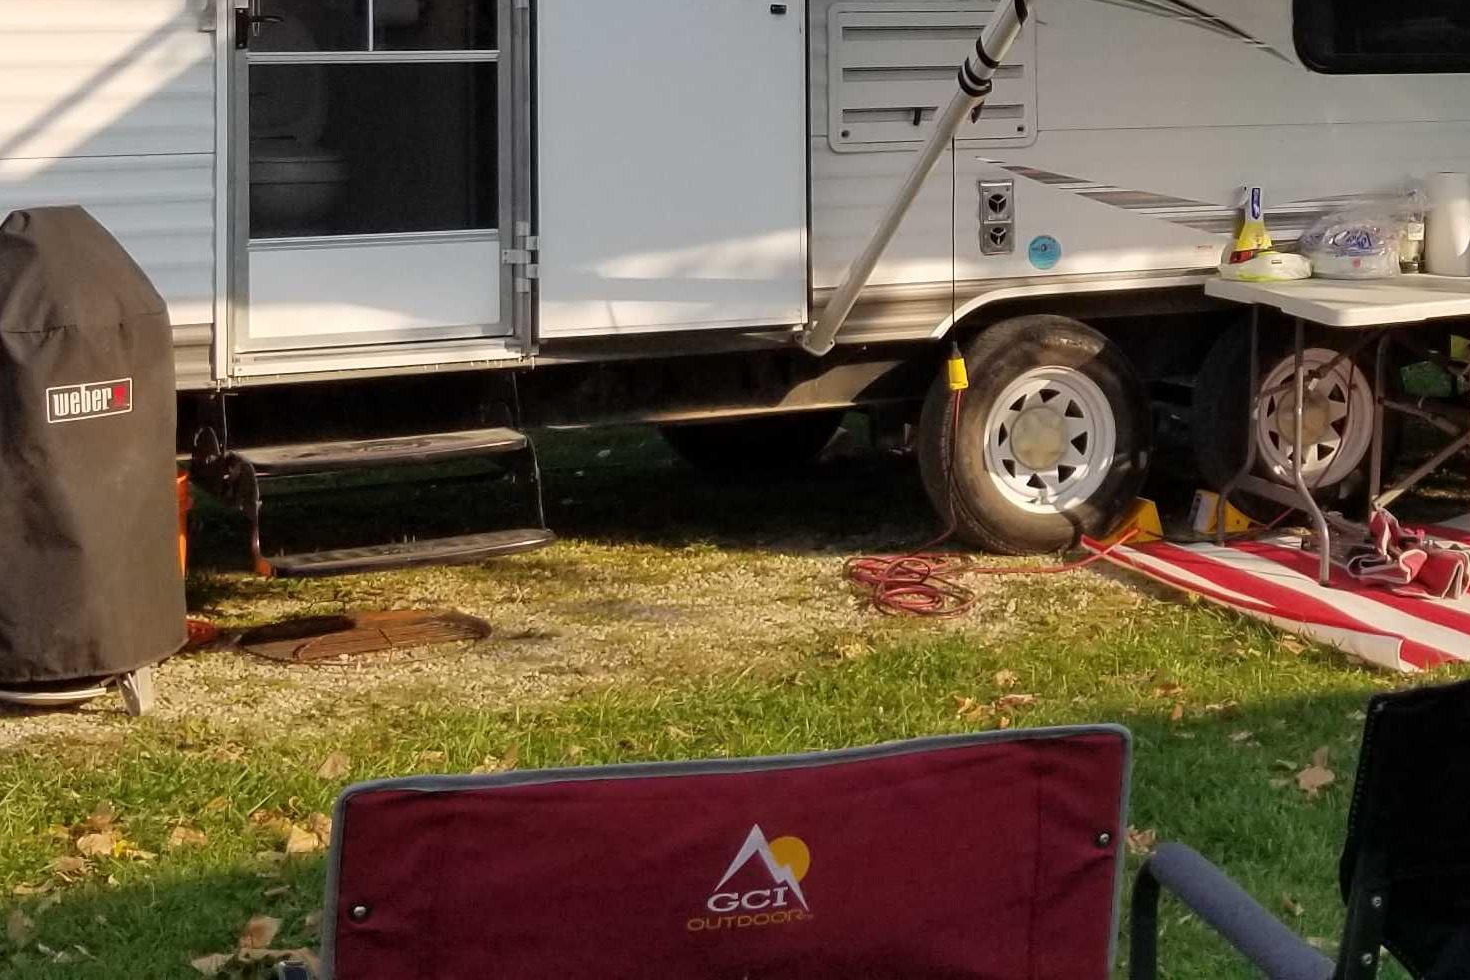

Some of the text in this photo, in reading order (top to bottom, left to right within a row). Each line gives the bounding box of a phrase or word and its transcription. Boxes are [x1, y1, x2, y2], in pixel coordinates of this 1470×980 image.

[53, 384, 113, 417] weber
[707, 886, 789, 912] GCI
[687, 908, 803, 932] OUTDOOR
